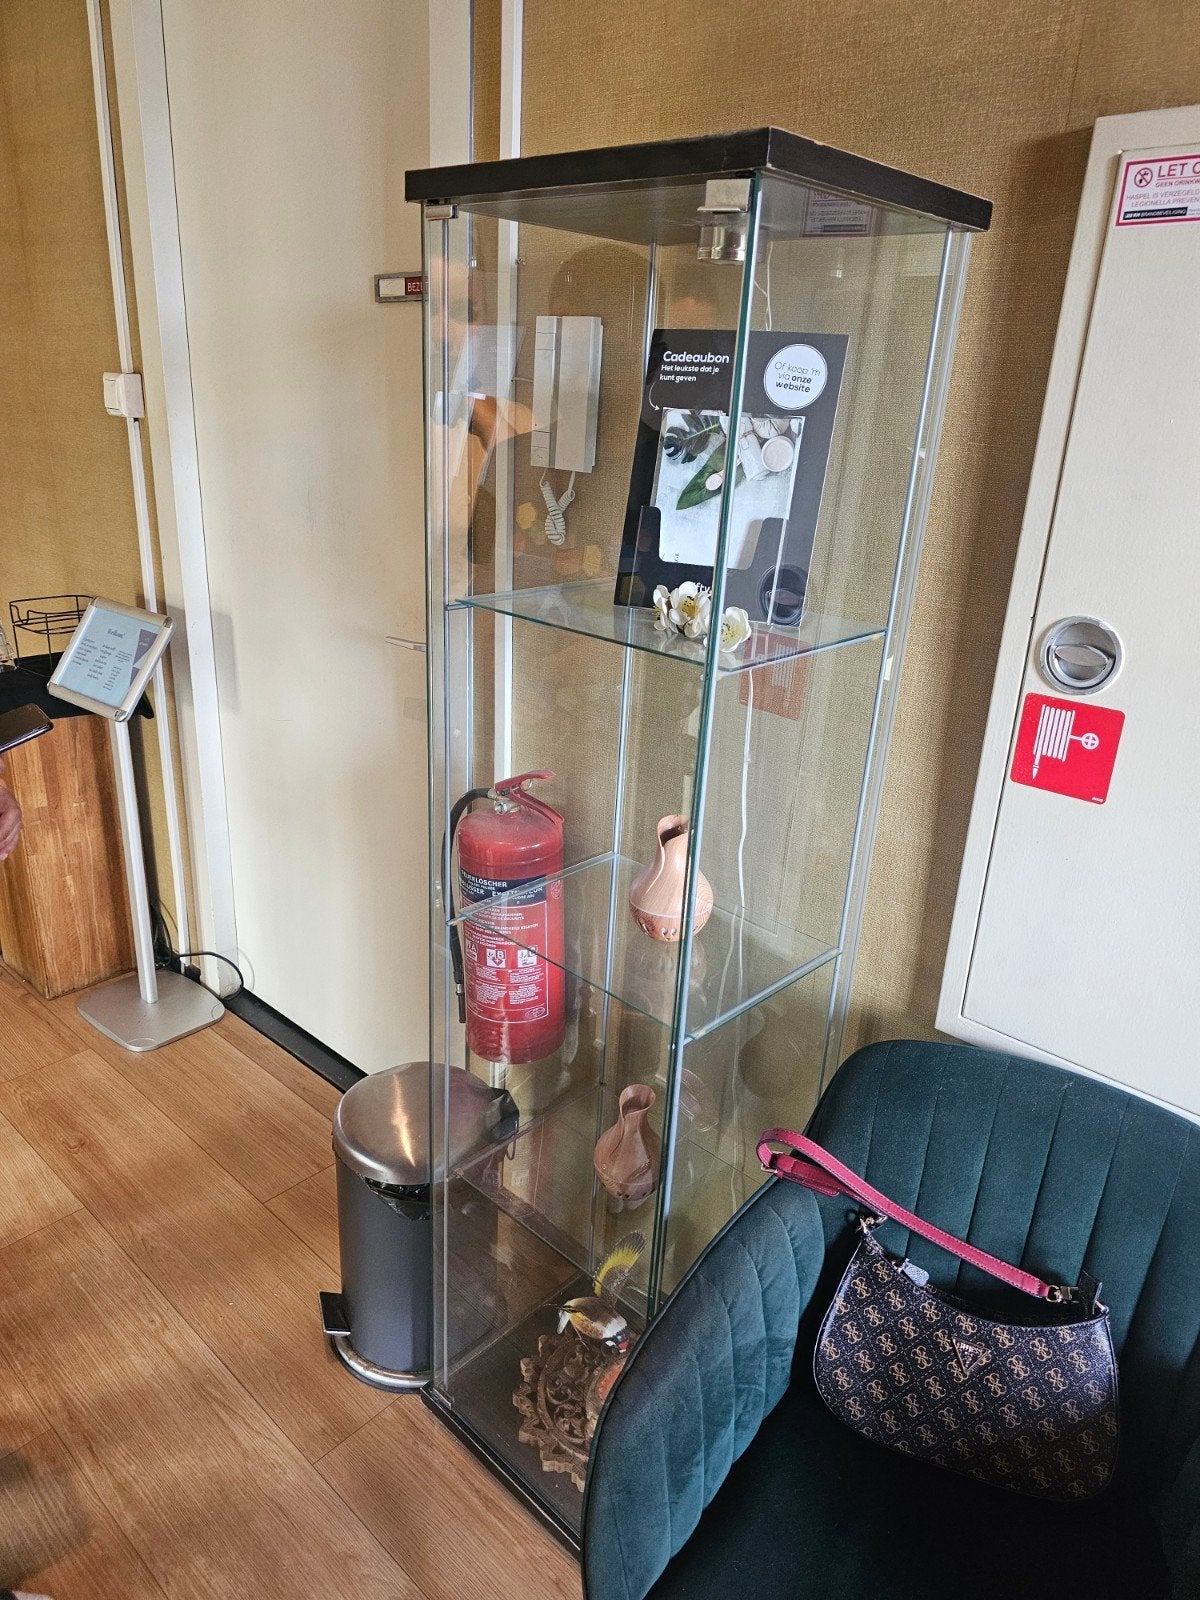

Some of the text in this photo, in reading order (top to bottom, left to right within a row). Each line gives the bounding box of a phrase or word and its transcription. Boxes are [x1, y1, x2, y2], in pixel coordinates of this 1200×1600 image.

[1158, 161, 1200, 178] LET O
[1174, 178, 1200, 186] DRINKW
[1127, 193, 1150, 201] HASPEL
[1172, 197, 1200, 205] PREVEN
[663, 351, 730, 363] Cadeaubon
[712, 366, 720, 375] je
[775, 362, 786, 370] Of
[787, 364, 809, 376] koop
[779, 372, 812, 384] via onze
[776, 382, 811, 393] website
